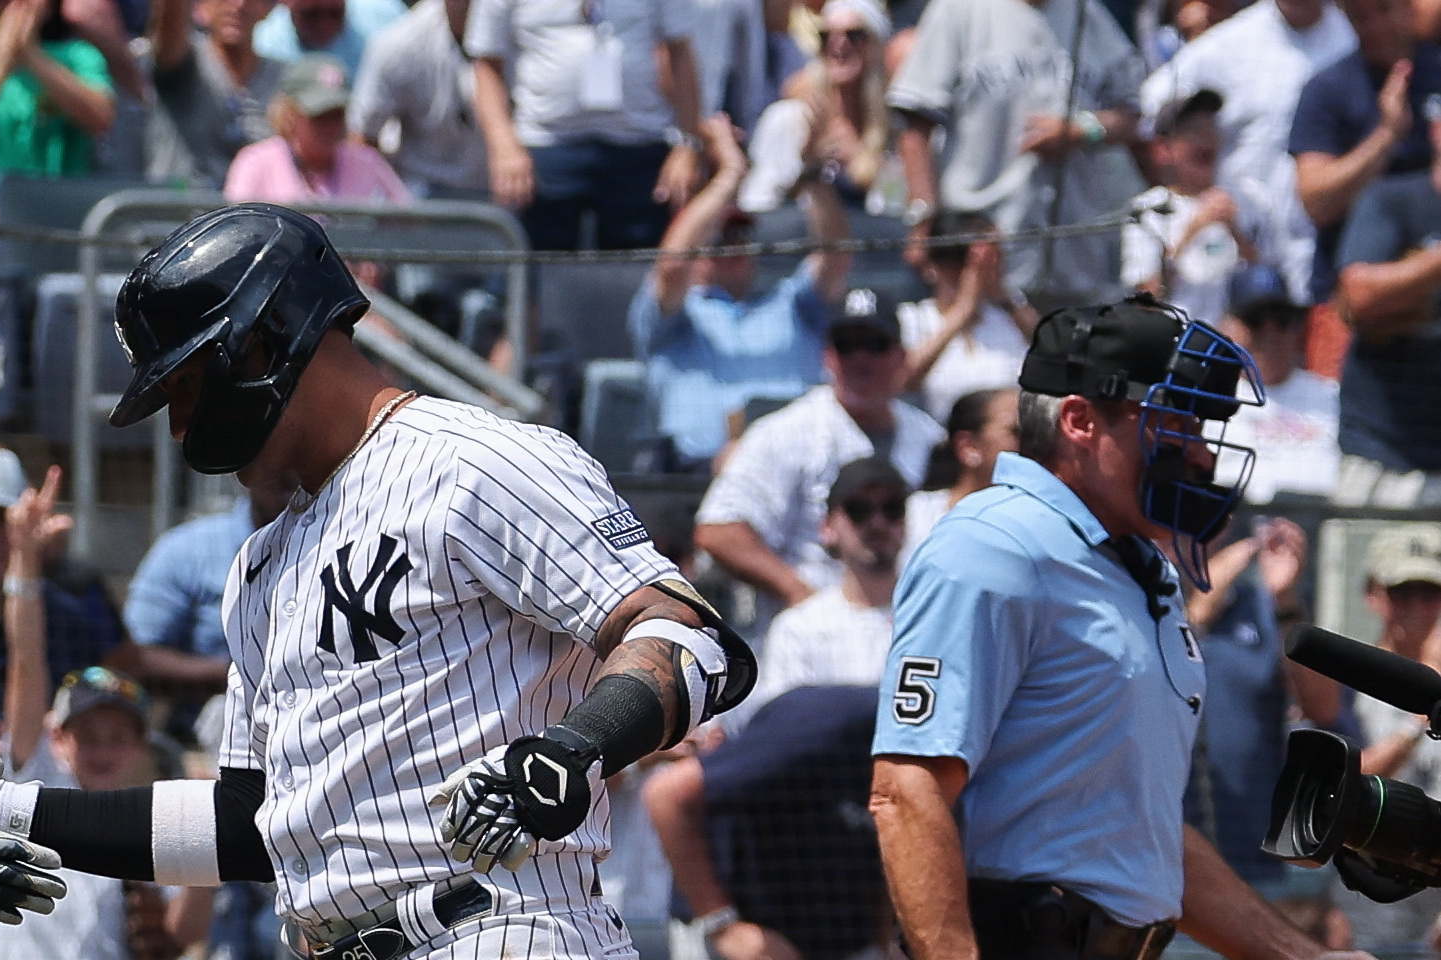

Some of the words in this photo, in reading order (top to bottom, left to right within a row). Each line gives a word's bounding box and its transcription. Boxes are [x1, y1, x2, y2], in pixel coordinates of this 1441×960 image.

[595, 510, 642, 536] STARR
[317, 532, 415, 665] NY
[893, 656, 942, 727] 5
